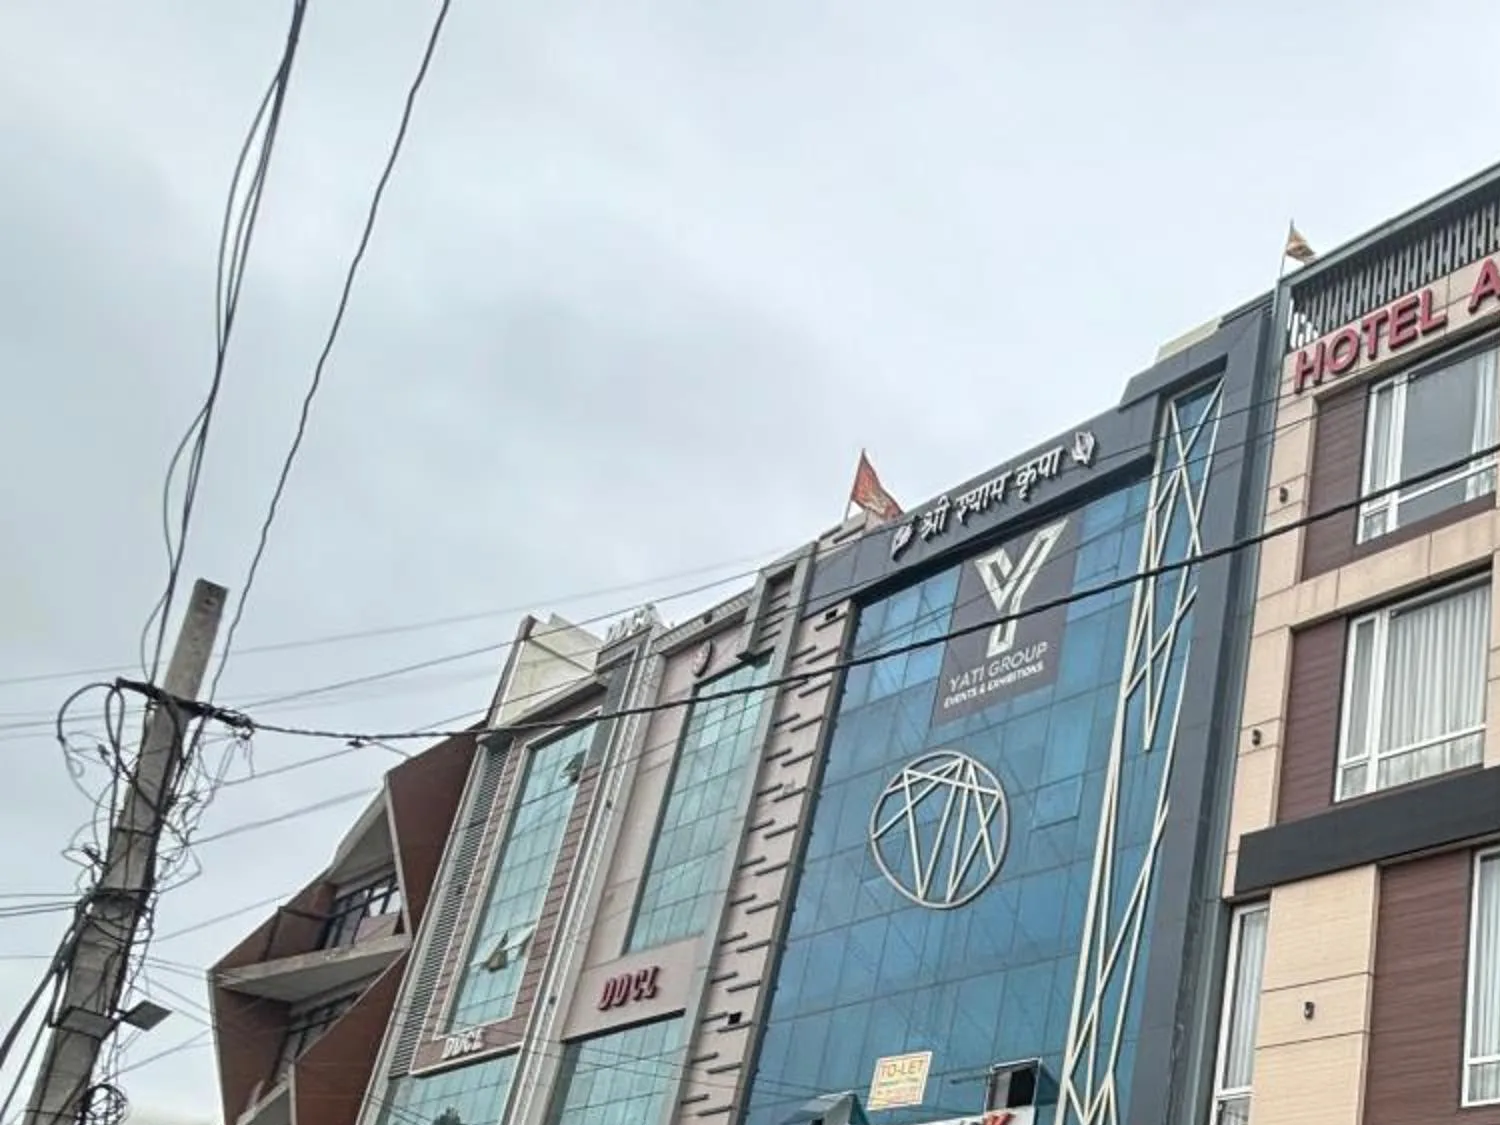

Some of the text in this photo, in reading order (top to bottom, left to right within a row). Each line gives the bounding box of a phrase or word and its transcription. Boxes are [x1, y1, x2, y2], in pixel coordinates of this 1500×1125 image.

[1294, 295, 1447, 393] HOTEL
[1015, 445, 1064, 498] कृपा
[950, 641, 1048, 692] YATI GROUP
